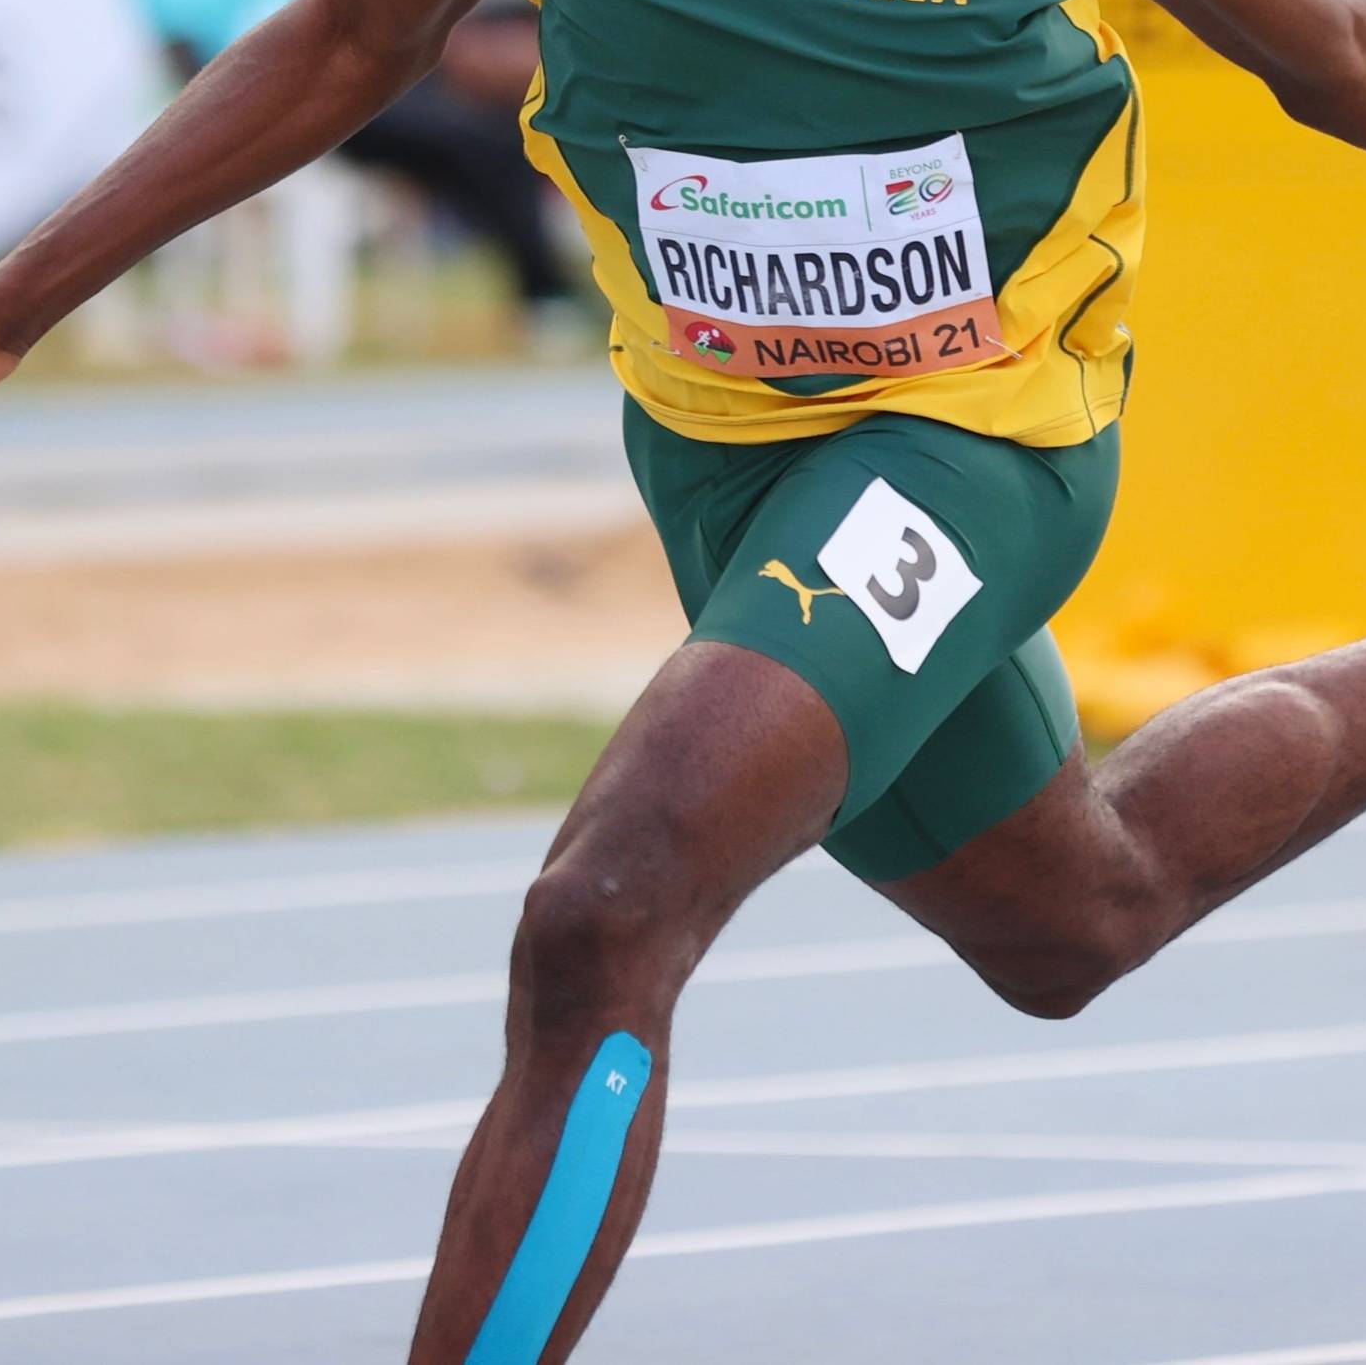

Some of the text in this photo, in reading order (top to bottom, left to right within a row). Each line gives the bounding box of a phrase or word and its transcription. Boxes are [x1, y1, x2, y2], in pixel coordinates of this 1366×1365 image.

[889, 159, 943, 179] BEYOND
[680, 186, 847, 220] Safaricom
[910, 208, 937, 222] YEARS
[657, 230, 972, 316] RICHARDSON
[754, 317, 981, 367] NAIROBI 21
[866, 526, 938, 622] 3
[605, 1069, 628, 1095] KT
